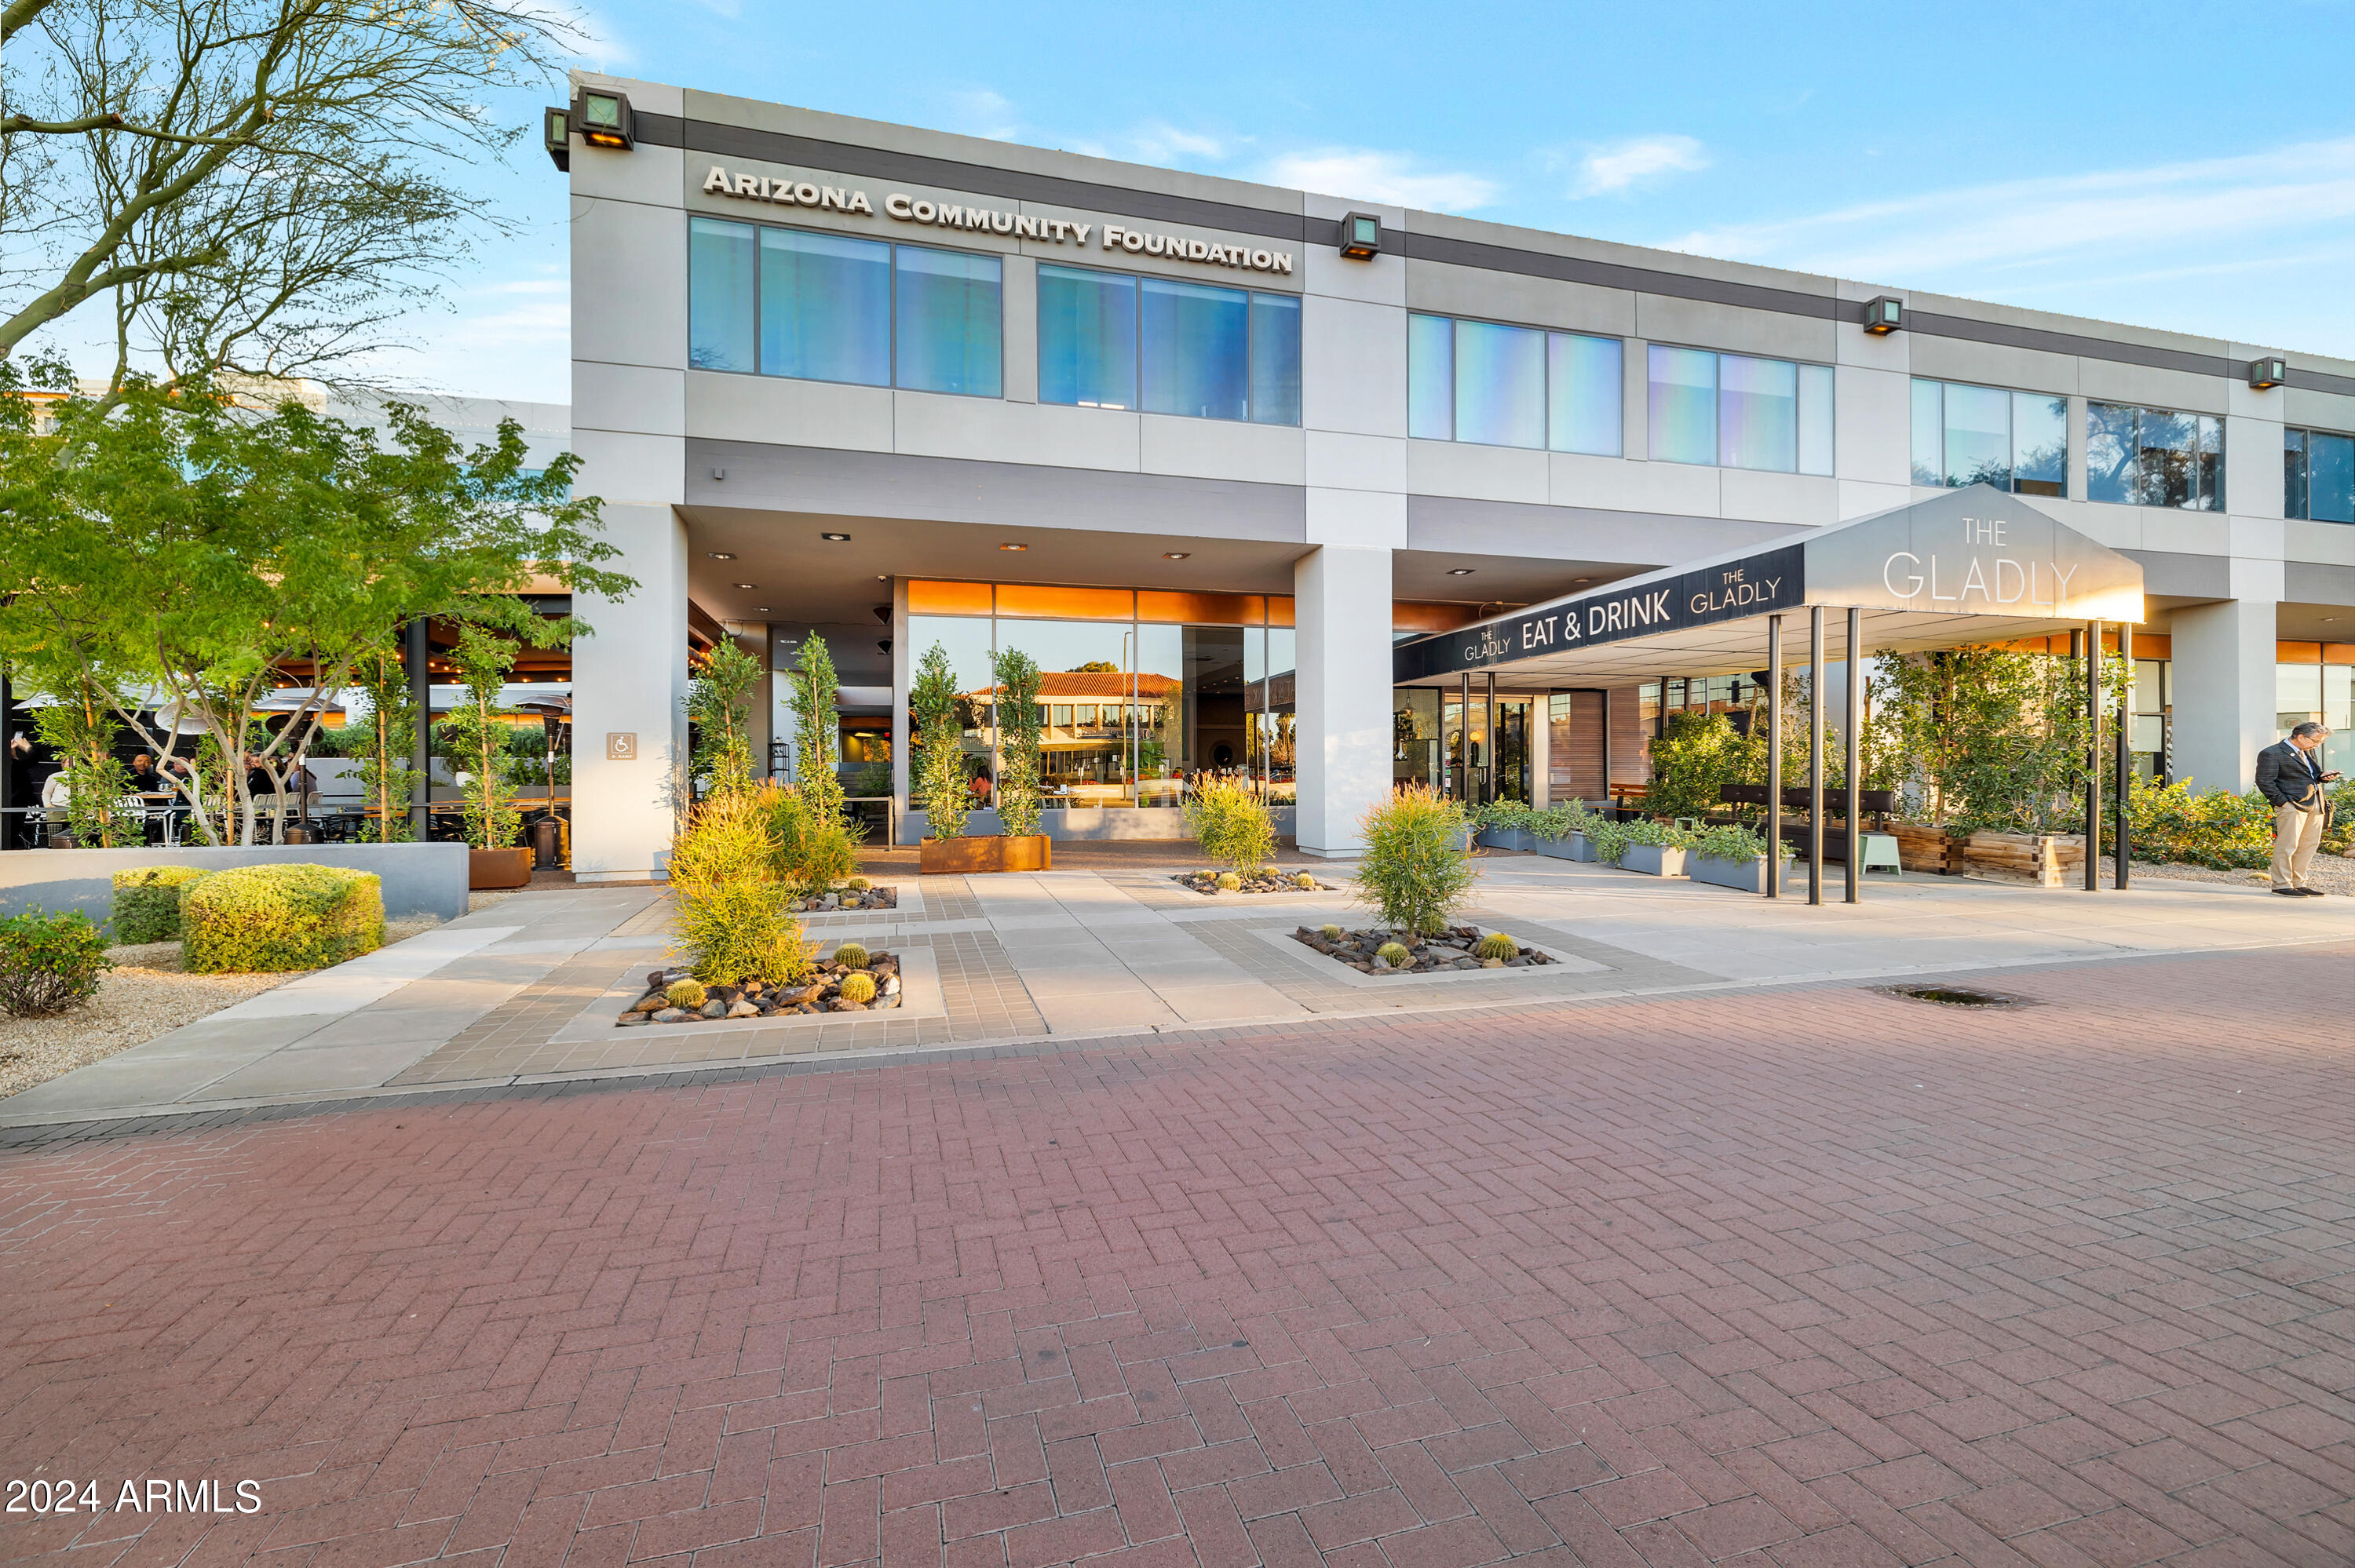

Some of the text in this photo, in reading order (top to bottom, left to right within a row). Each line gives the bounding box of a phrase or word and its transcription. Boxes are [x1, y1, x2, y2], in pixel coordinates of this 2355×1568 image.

[1962, 518, 2006, 546] THE
[1722, 569, 1744, 585] THE
[1883, 552, 2078, 606] GLADLY
[1690, 576, 1782, 614] GLADLY
[1522, 589, 1670, 650] EAT & DRINK
[1465, 637, 1511, 661] GLADLY
[1481, 630, 1492, 641] THE
